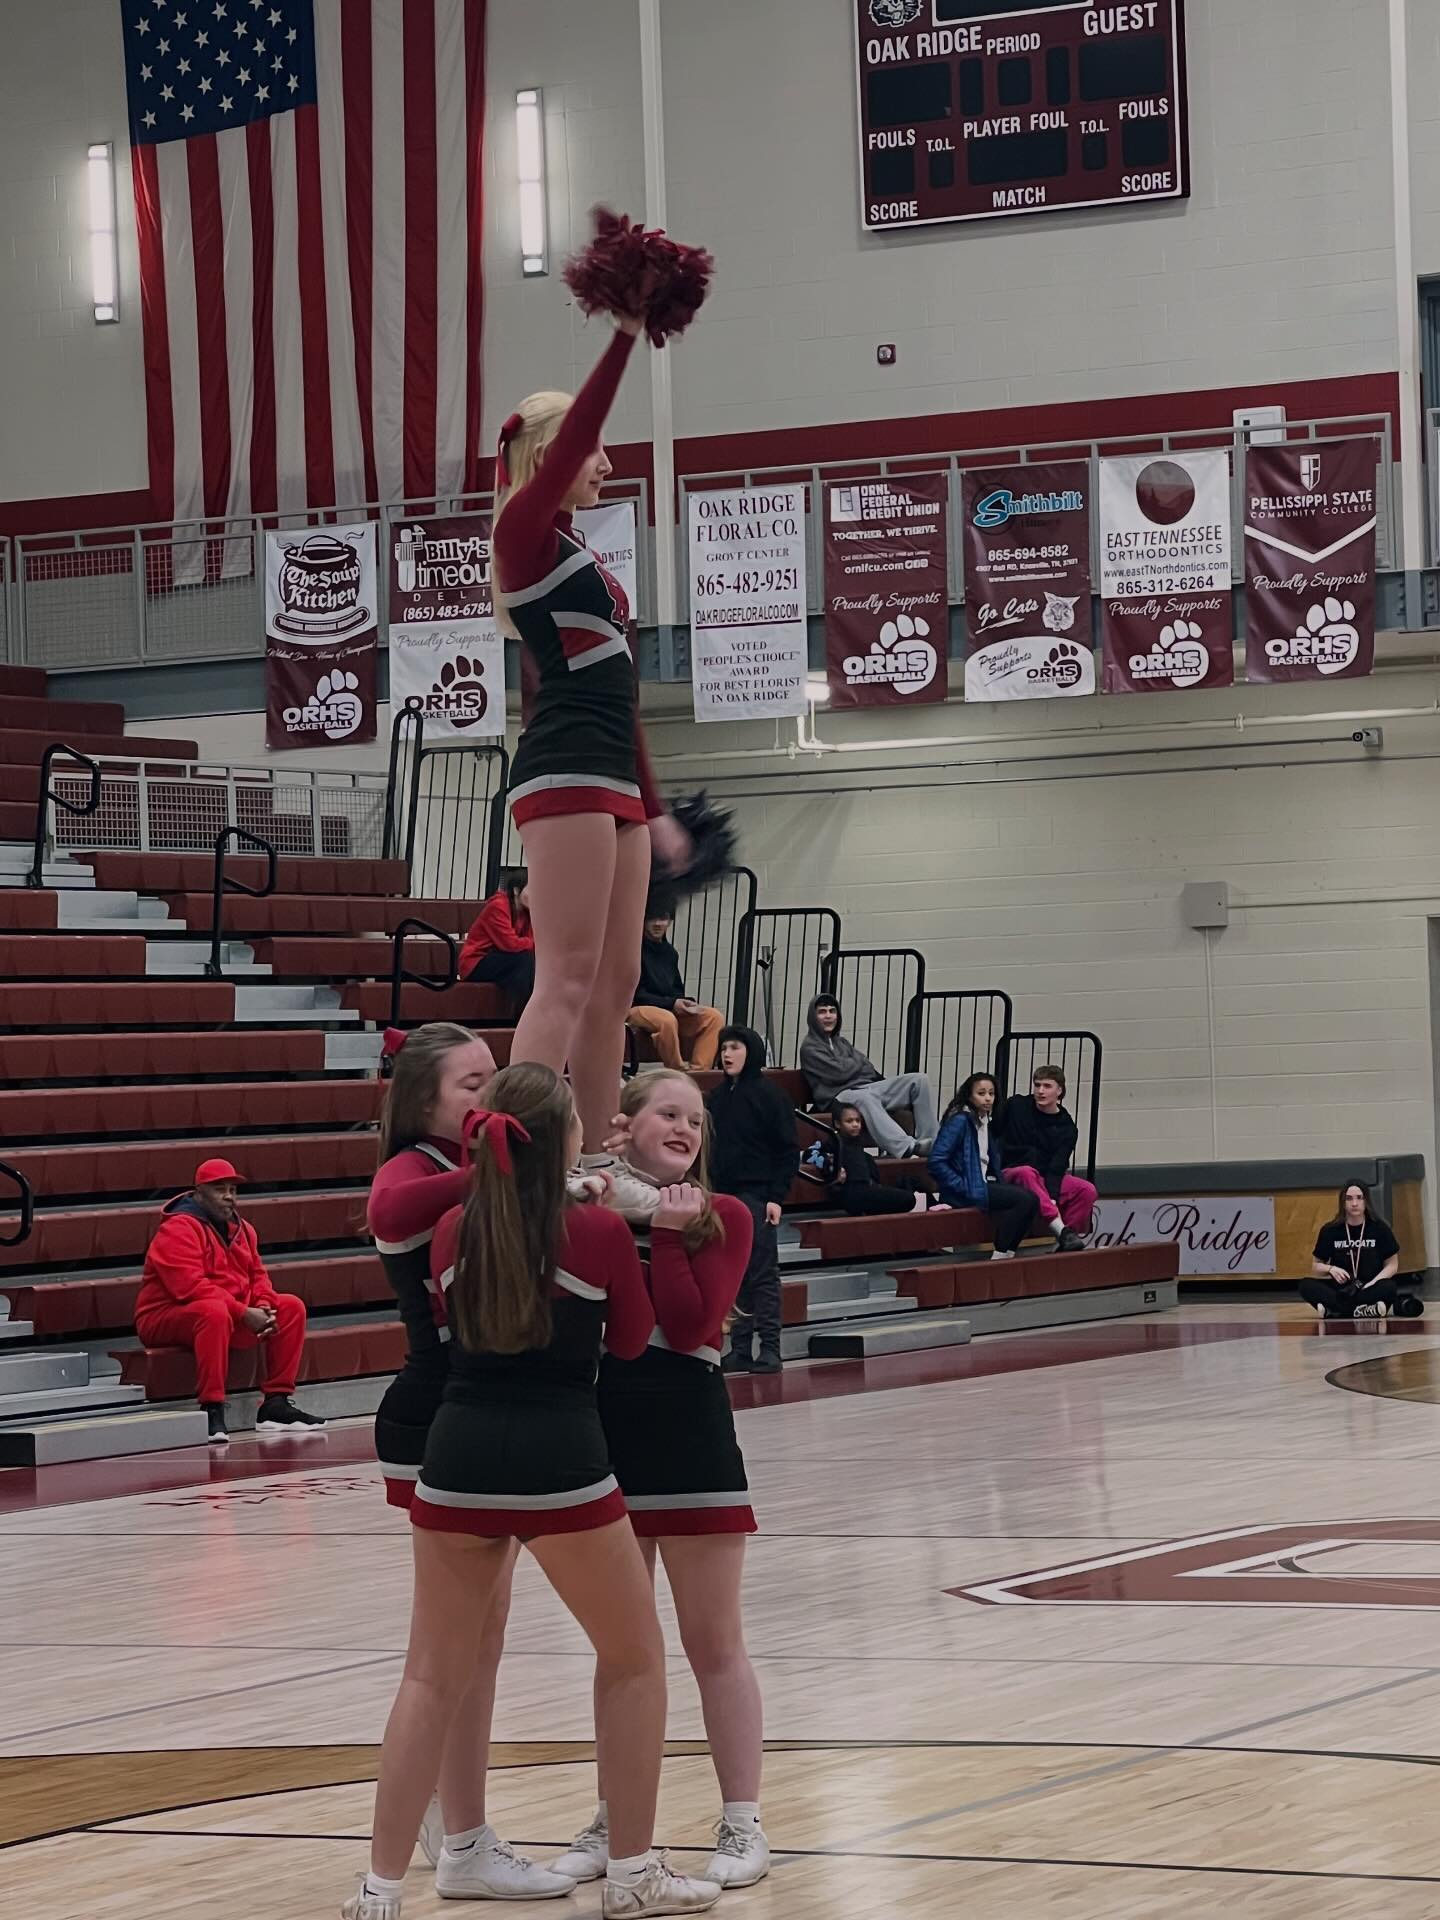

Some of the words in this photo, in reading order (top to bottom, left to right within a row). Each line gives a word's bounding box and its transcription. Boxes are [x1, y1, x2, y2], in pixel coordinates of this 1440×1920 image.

[1083, 3, 1158, 36] GUEST
[867, 38, 910, 64] OAK
[917, 26, 983, 58] RIDGE
[987, 33, 1041, 56] PERIOD
[1119, 98, 1169, 120] FOULS
[963, 116, 1021, 139] PLAYER
[1030, 111, 1069, 131] FOUL
[1080, 119, 1109, 134] T.O.L.
[869, 128, 916, 150] FOULS
[926, 138, 955, 152] T.O.L.
[1121, 171, 1171, 193] SCORE
[993, 186, 1045, 208] MATCH
[870, 200, 918, 222] SCORE
[860, 484, 891, 497] ORNL
[861, 493, 912, 509] FEDERAL
[1251, 493, 1328, 510] PELLISSIPPI
[1332, 489, 1373, 505] STATE
[699, 499, 733, 519] OAK
[739, 494, 796, 516] RIDGE
[862, 506, 903, 521] CREDIT
[905, 502, 940, 518] UNION
[973, 489, 1083, 528] Smithbilt
[1251, 508, 1316, 519] COMMUNITY
[1323, 503, 1373, 515] COLLEGE
[697, 521, 768, 542] FLORAL
[772, 518, 798, 537] CO.
[887, 528, 902, 538] WE
[1107, 531, 1140, 549] EAST
[1142, 525, 1222, 545] TENNESSEE
[425, 537, 490, 562] Billy's
[706, 551, 743, 562] GROVE
[746, 547, 790, 560] CENTER
[988, 545, 1068, 561] 865-694-8582
[1108, 543, 1223, 562] ORTHODONTICS
[286, 565, 319, 586] The
[320, 563, 359, 589] Soup
[417, 561, 490, 587] timeou
[845, 562, 904, 574] ornlfcu.com
[697, 568, 799, 597] 865-482-9251
[1117, 575, 1214, 594] 865-312-6264
[1253, 573, 1307, 594] Proudly
[1310, 571, 1368, 592] Supports
[288, 585, 356, 610] Kitchen
[832, 595, 883, 615] Proudly
[885, 592, 941, 611] Supports
[403, 606, 435, 622] (865)
[437, 602, 491, 618] 483-6784
[696, 604, 799, 625] OAKRIDGEFLORALCO.COM
[978, 603, 998, 626] Go
[1003, 598, 1039, 619] Cats
[1109, 600, 1161, 620] Proudly
[1163, 598, 1222, 617] Supports
[398, 633, 444, 651] Proudly
[446, 631, 496, 650] Supports
[730, 641, 767, 652] VOTED
[1265, 635, 1351, 657] ORHS
[843, 651, 928, 676] ORHS
[978, 645, 1020, 668] Proudly
[988, 652, 1032, 676] Supports
[1129, 651, 1200, 672] ORHS
[1269, 654, 1347, 666] BASKETBALL
[729, 665, 770, 677] AWARD
[847, 671, 926, 685] BASKETBALL
[1026, 665, 1076, 679] ORHS
[1132, 668, 1200, 679] BASKETBALL
[700, 681, 722, 692] FOR
[724, 680, 750, 691] BEST
[753, 676, 801, 689] FLORIST
[405, 693, 479, 710] ORHS
[711, 694, 723, 703] IN
[726, 692, 750, 703] OAK
[753, 690, 790, 701] RIDGE
[283, 702, 354, 723] ORHS
[287, 721, 352, 732] BASKETBALL
[1152, 1203, 1271, 1271] Ridge
[1334, 1238, 1376, 1250] WILDCATS
